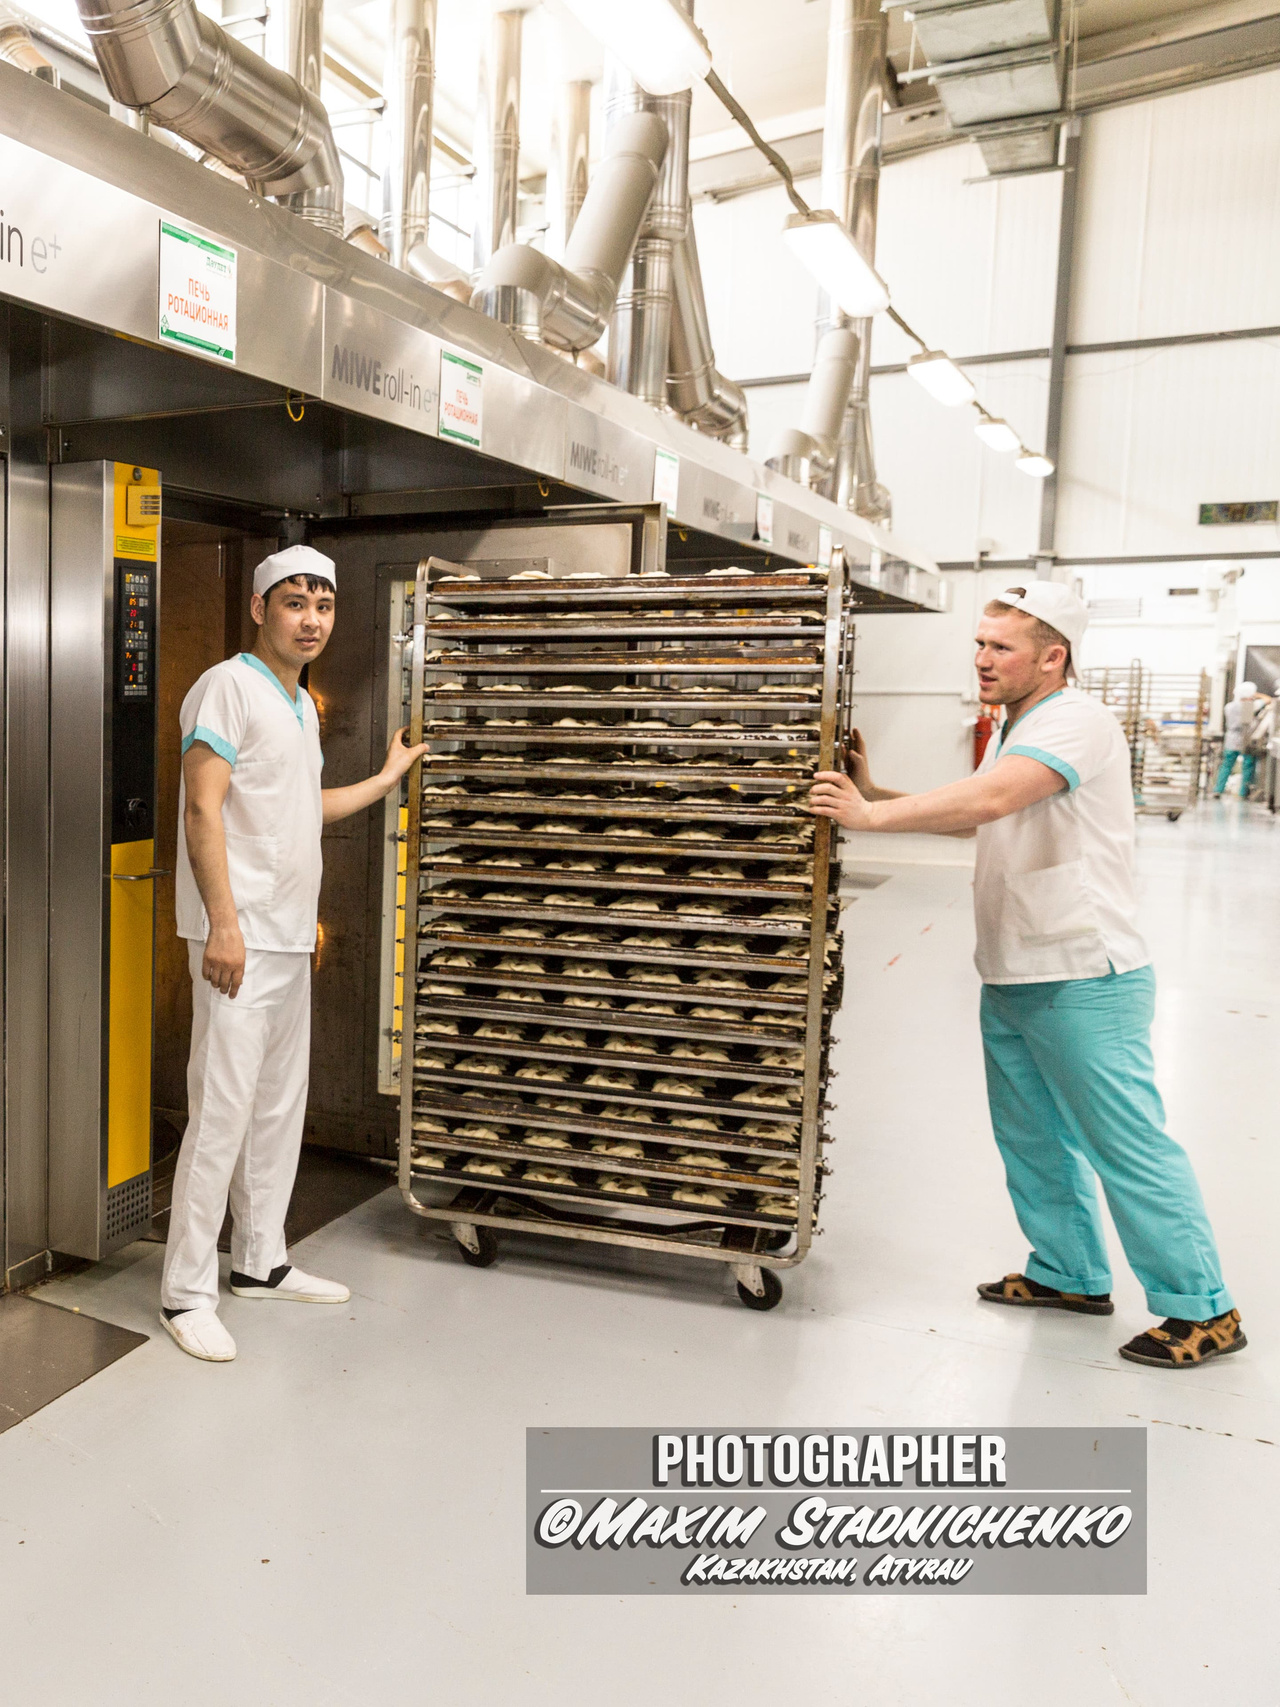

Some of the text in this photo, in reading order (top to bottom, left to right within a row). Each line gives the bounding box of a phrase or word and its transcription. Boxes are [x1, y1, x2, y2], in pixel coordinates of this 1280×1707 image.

[188, 277, 210, 302] ПЕЧЬ
[167, 293, 229, 331] РОТАЦИОННАЯ
[331, 344, 382, 396] MIWE
[383, 367, 421, 411] roll-in
[569, 441, 598, 475] MIWE
